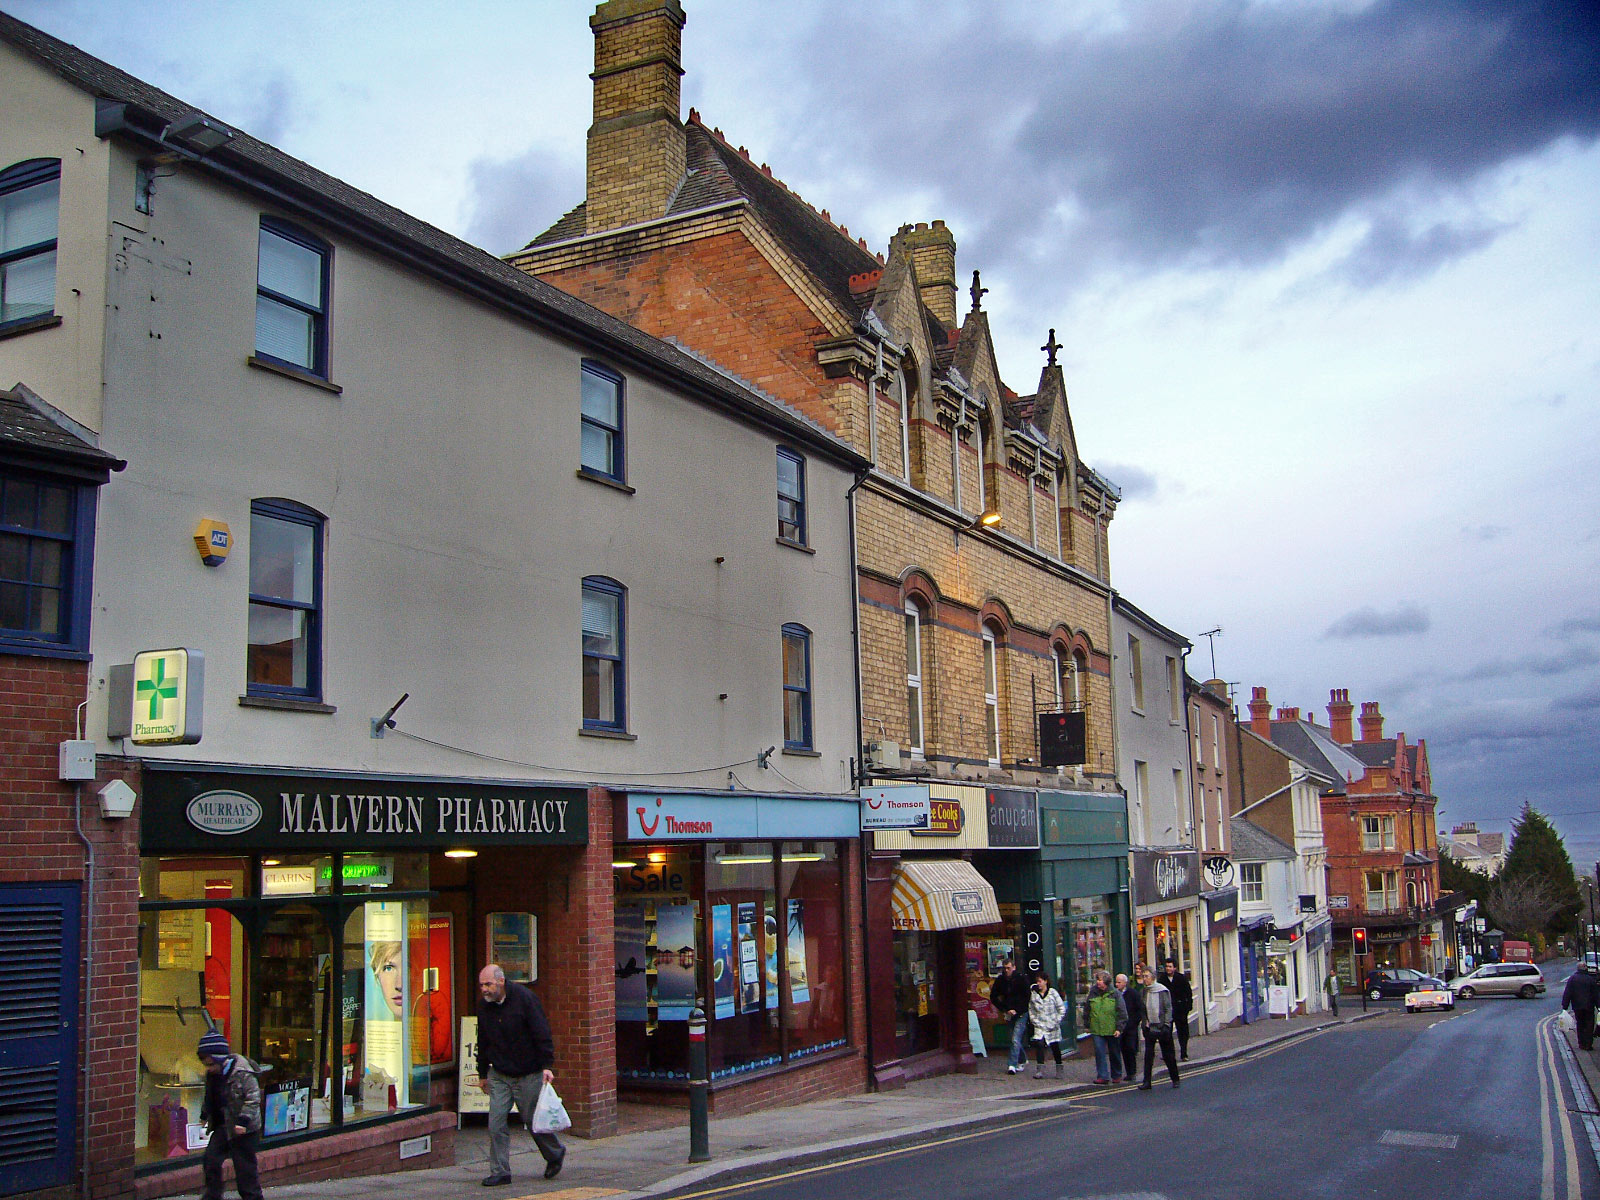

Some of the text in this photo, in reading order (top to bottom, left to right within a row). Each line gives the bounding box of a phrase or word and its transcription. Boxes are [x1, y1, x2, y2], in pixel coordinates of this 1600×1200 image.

[212, 533, 228, 545] ADT
[134, 723, 177, 735] Pharmacy
[197, 802, 254, 818] MURRAYS
[887, 800, 924, 809] Thomson
[279, 792, 568, 834] MALVERN PHARMACY
[937, 804, 958, 829] Cooks
[990, 806, 1036, 832] anupam
[203, 816, 247, 825] HEALTHCARE
[665, 815, 713, 834] Thomson
[265, 873, 312, 883] CLARINS
[321, 865, 387, 879] PRCRIPTIONS
[630, 864, 683, 892] Sale
[279, 1080, 300, 1092] VOGUE
